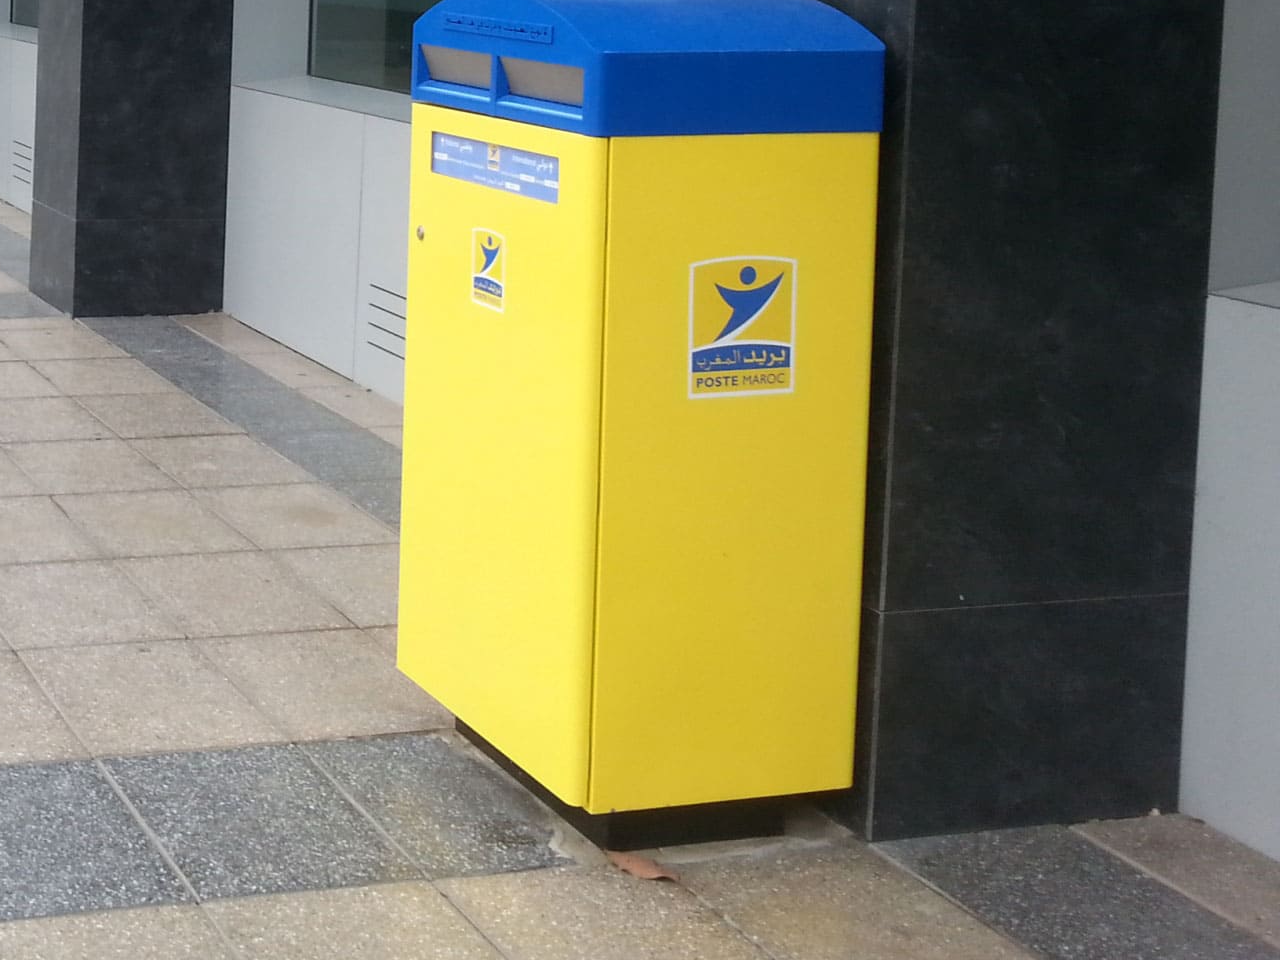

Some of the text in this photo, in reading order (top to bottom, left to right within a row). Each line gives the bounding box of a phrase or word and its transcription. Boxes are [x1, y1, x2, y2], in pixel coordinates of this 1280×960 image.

[696, 349, 786, 371] بريد المغرب
[696, 372, 786, 389] POSTE MAROC
